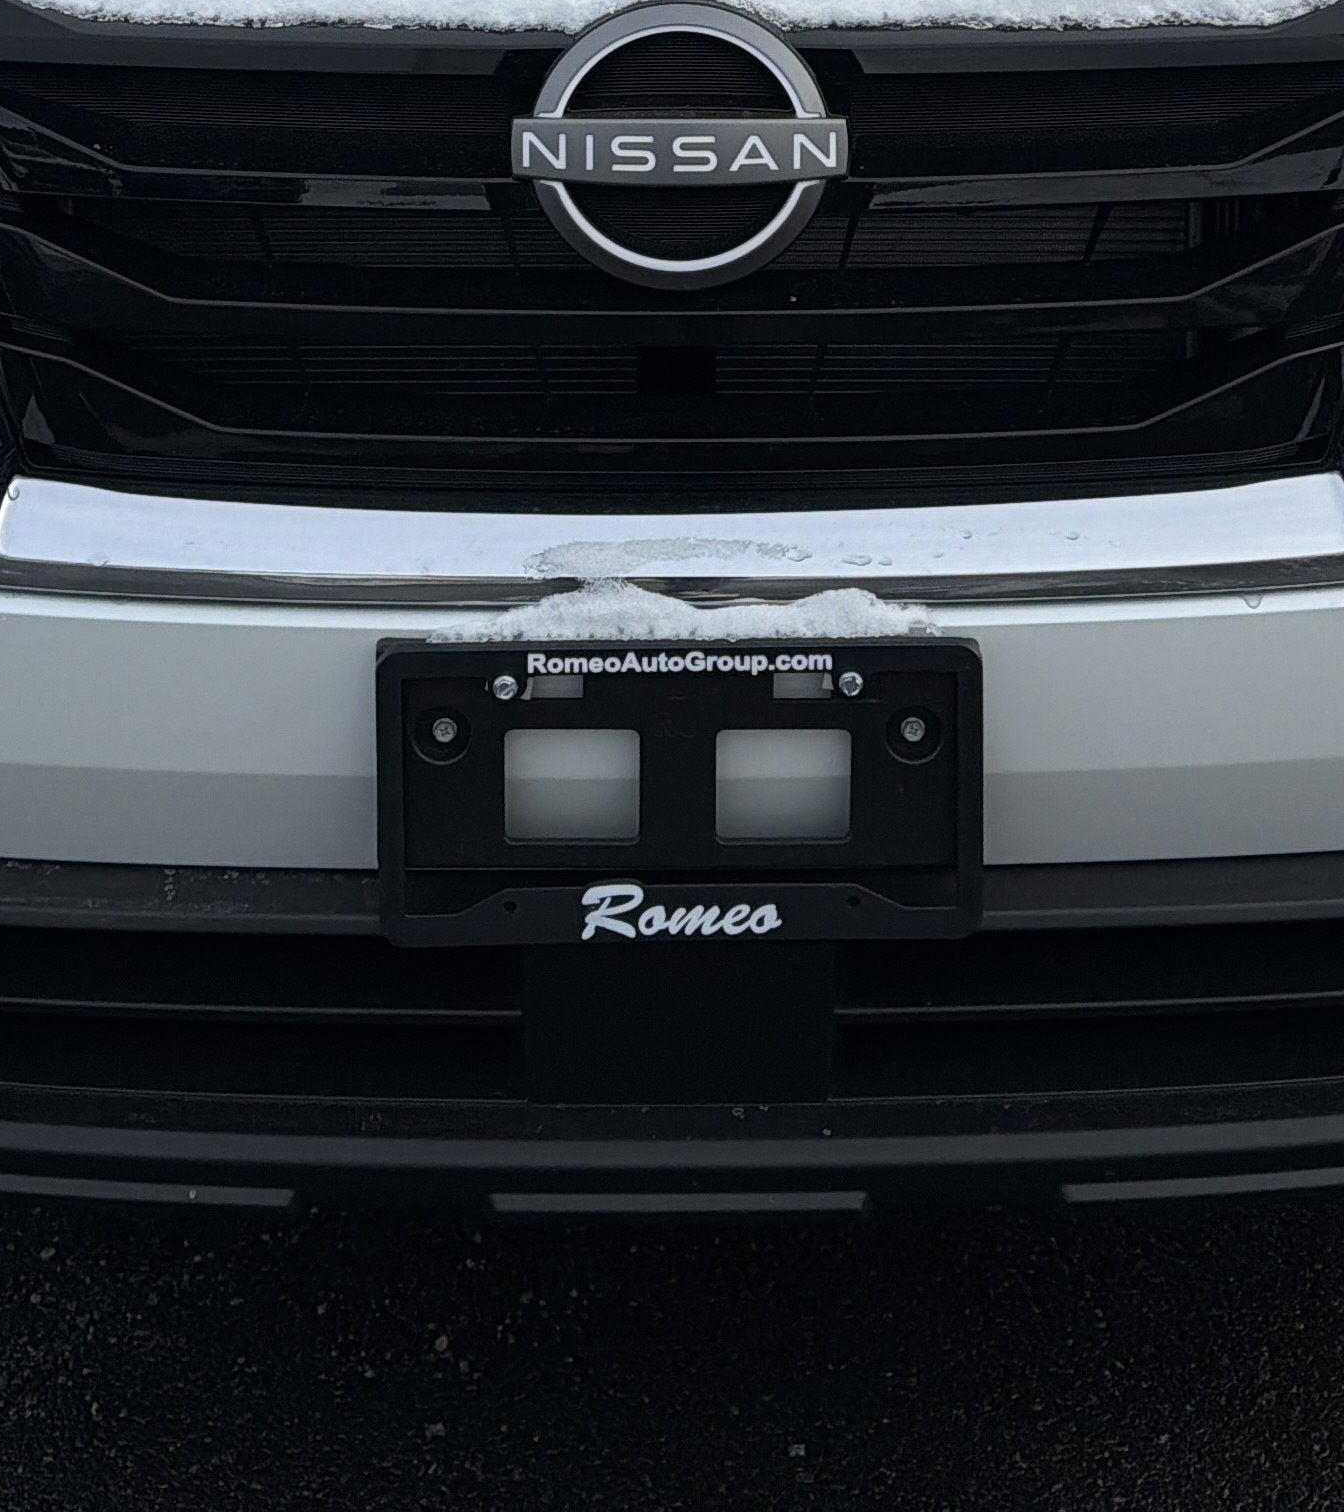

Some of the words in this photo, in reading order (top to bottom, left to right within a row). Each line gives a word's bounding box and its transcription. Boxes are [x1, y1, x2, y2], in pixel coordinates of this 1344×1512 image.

[522, 131, 837, 173] NISSAN
[527, 651, 833, 676] RomeoAutoGroup.com
[581, 884, 783, 941] Romeo
